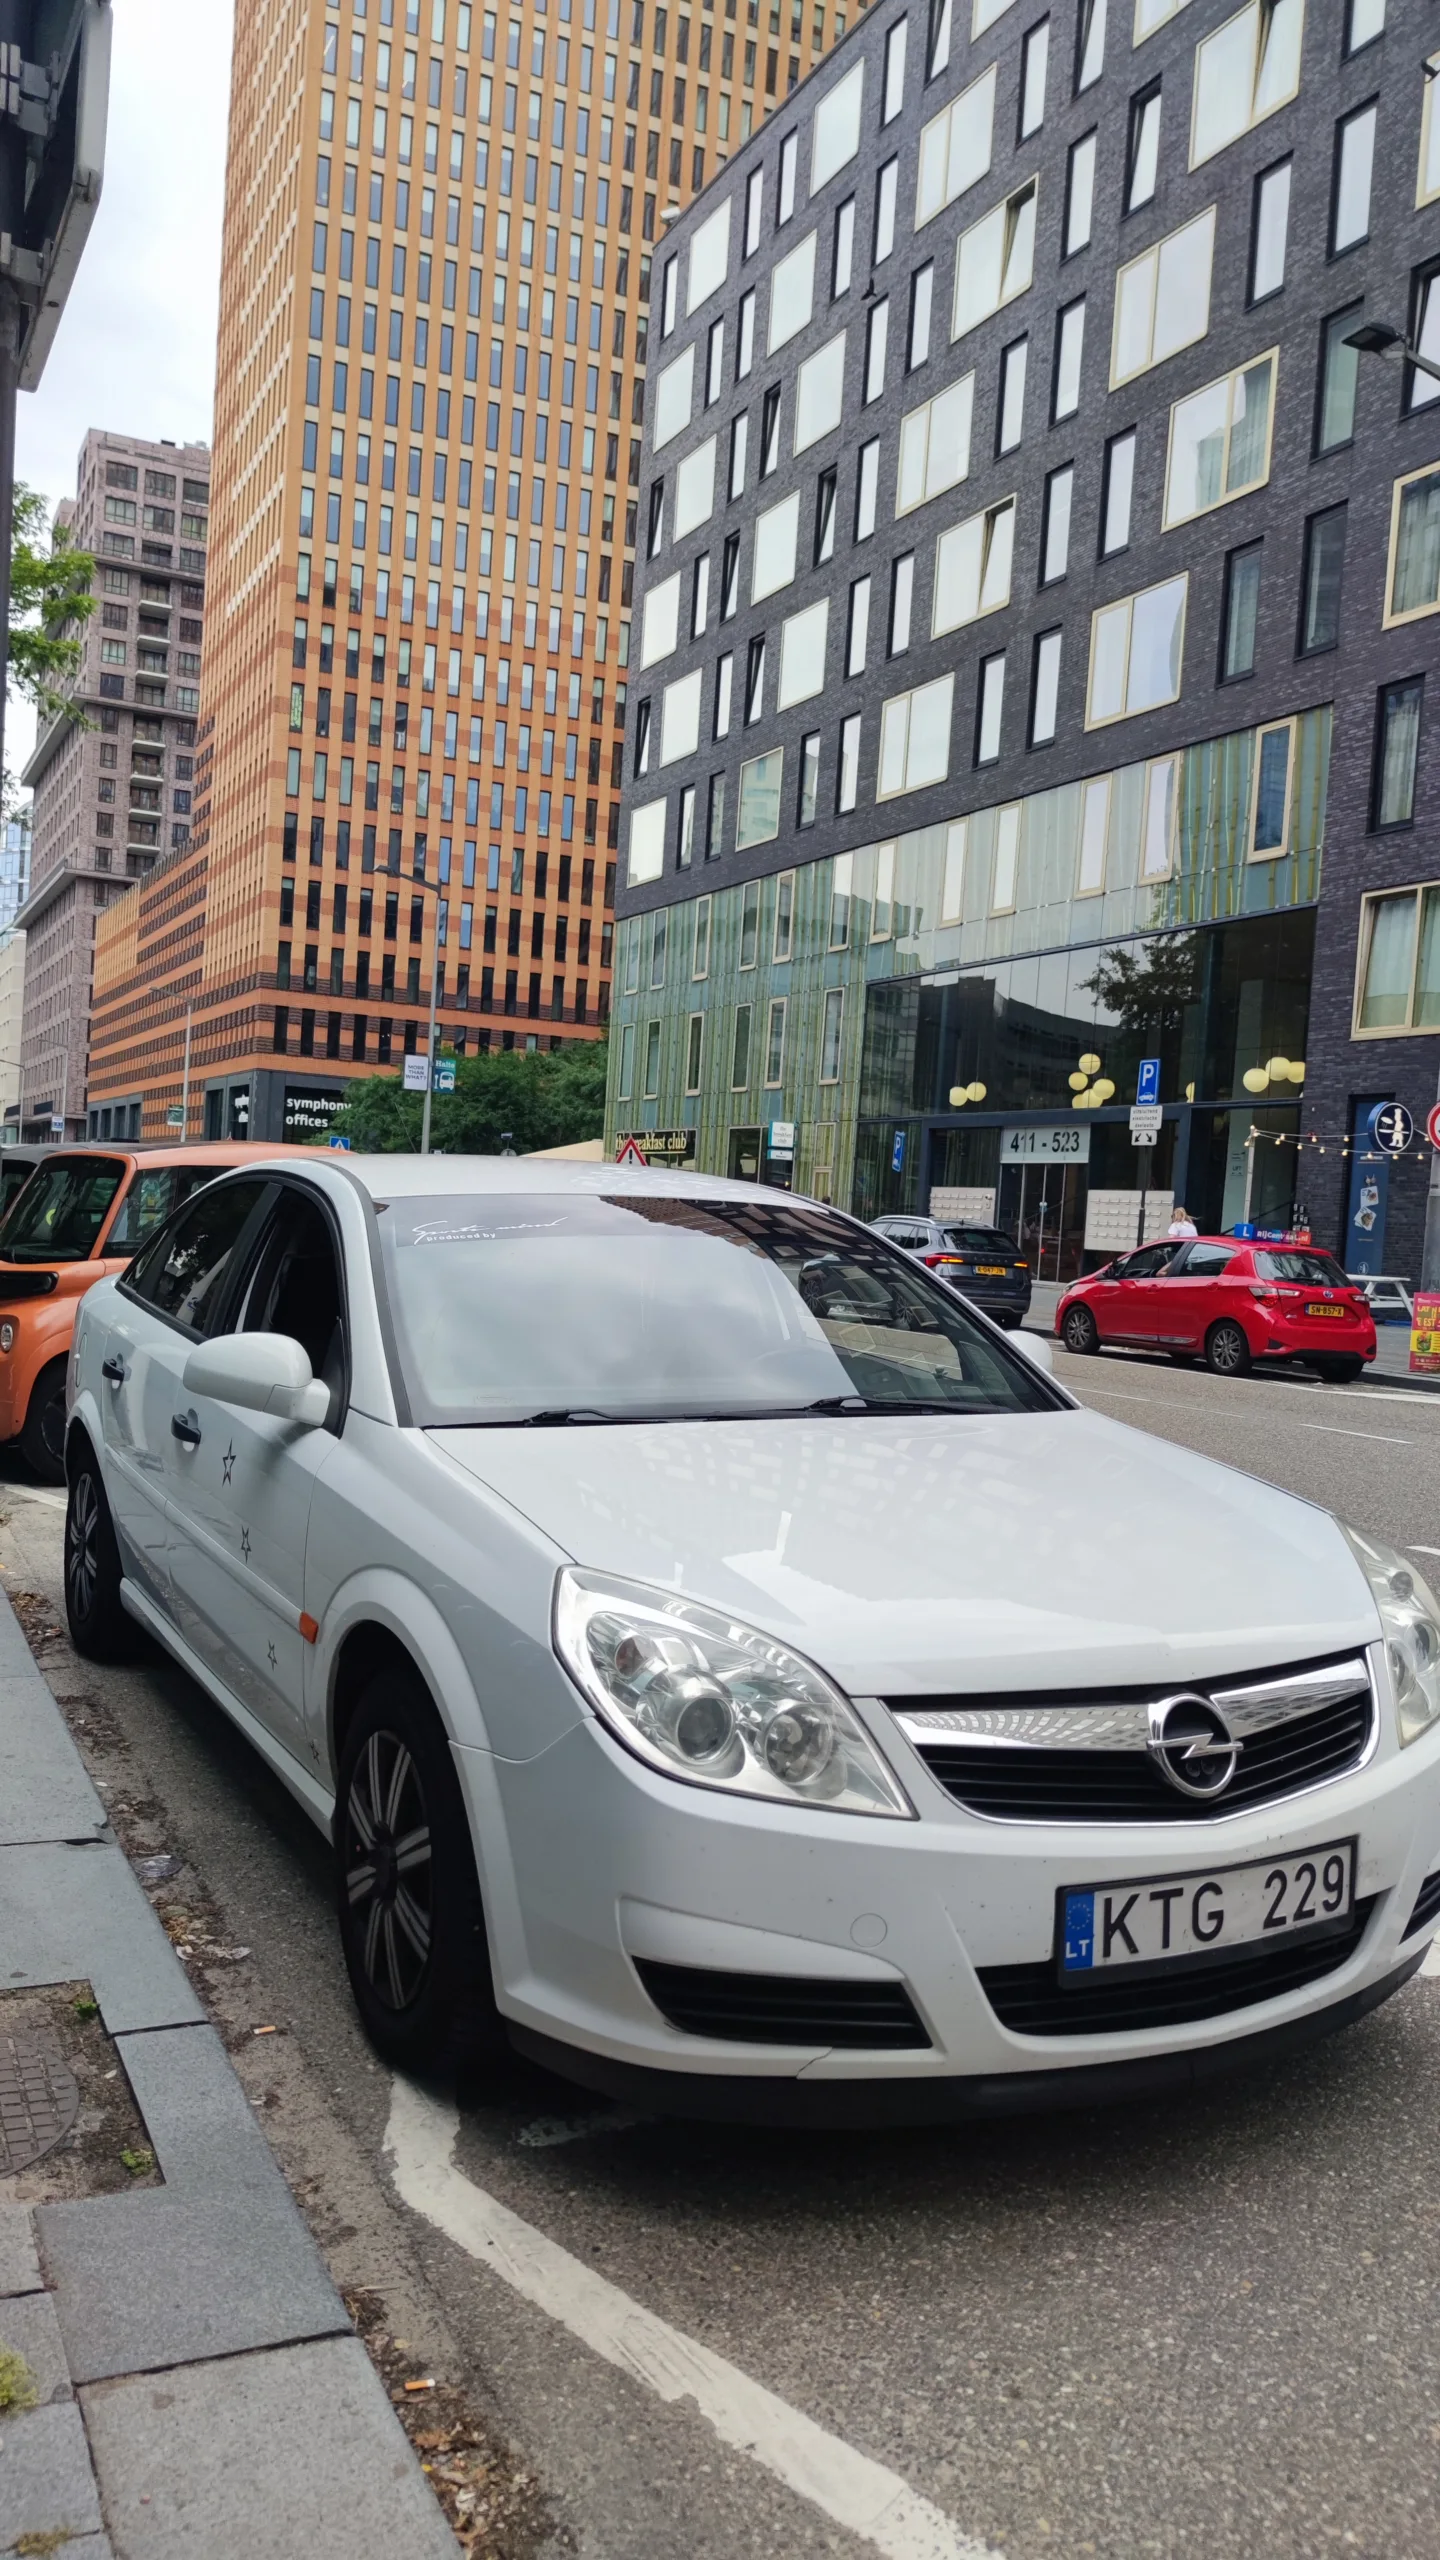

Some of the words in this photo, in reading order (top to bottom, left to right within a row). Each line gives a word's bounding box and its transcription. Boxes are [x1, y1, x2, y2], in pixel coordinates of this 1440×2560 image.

[435, 1059, 455, 1069] Halte
[1141, 1064, 1154, 1087] P
[285, 1113, 328, 1128] offices
[667, 1131, 687, 1150] club
[1010, 1132, 1035, 1153] 411
[1051, 1131, 1080, 1153] 523
[426, 1232, 480, 1242] produced
[1242, 1225, 1250, 1237] L
[1102, 1882, 1224, 1958] KTG
[1262, 1855, 1344, 1930] 229
[1065, 1939, 1090, 1959] LT
